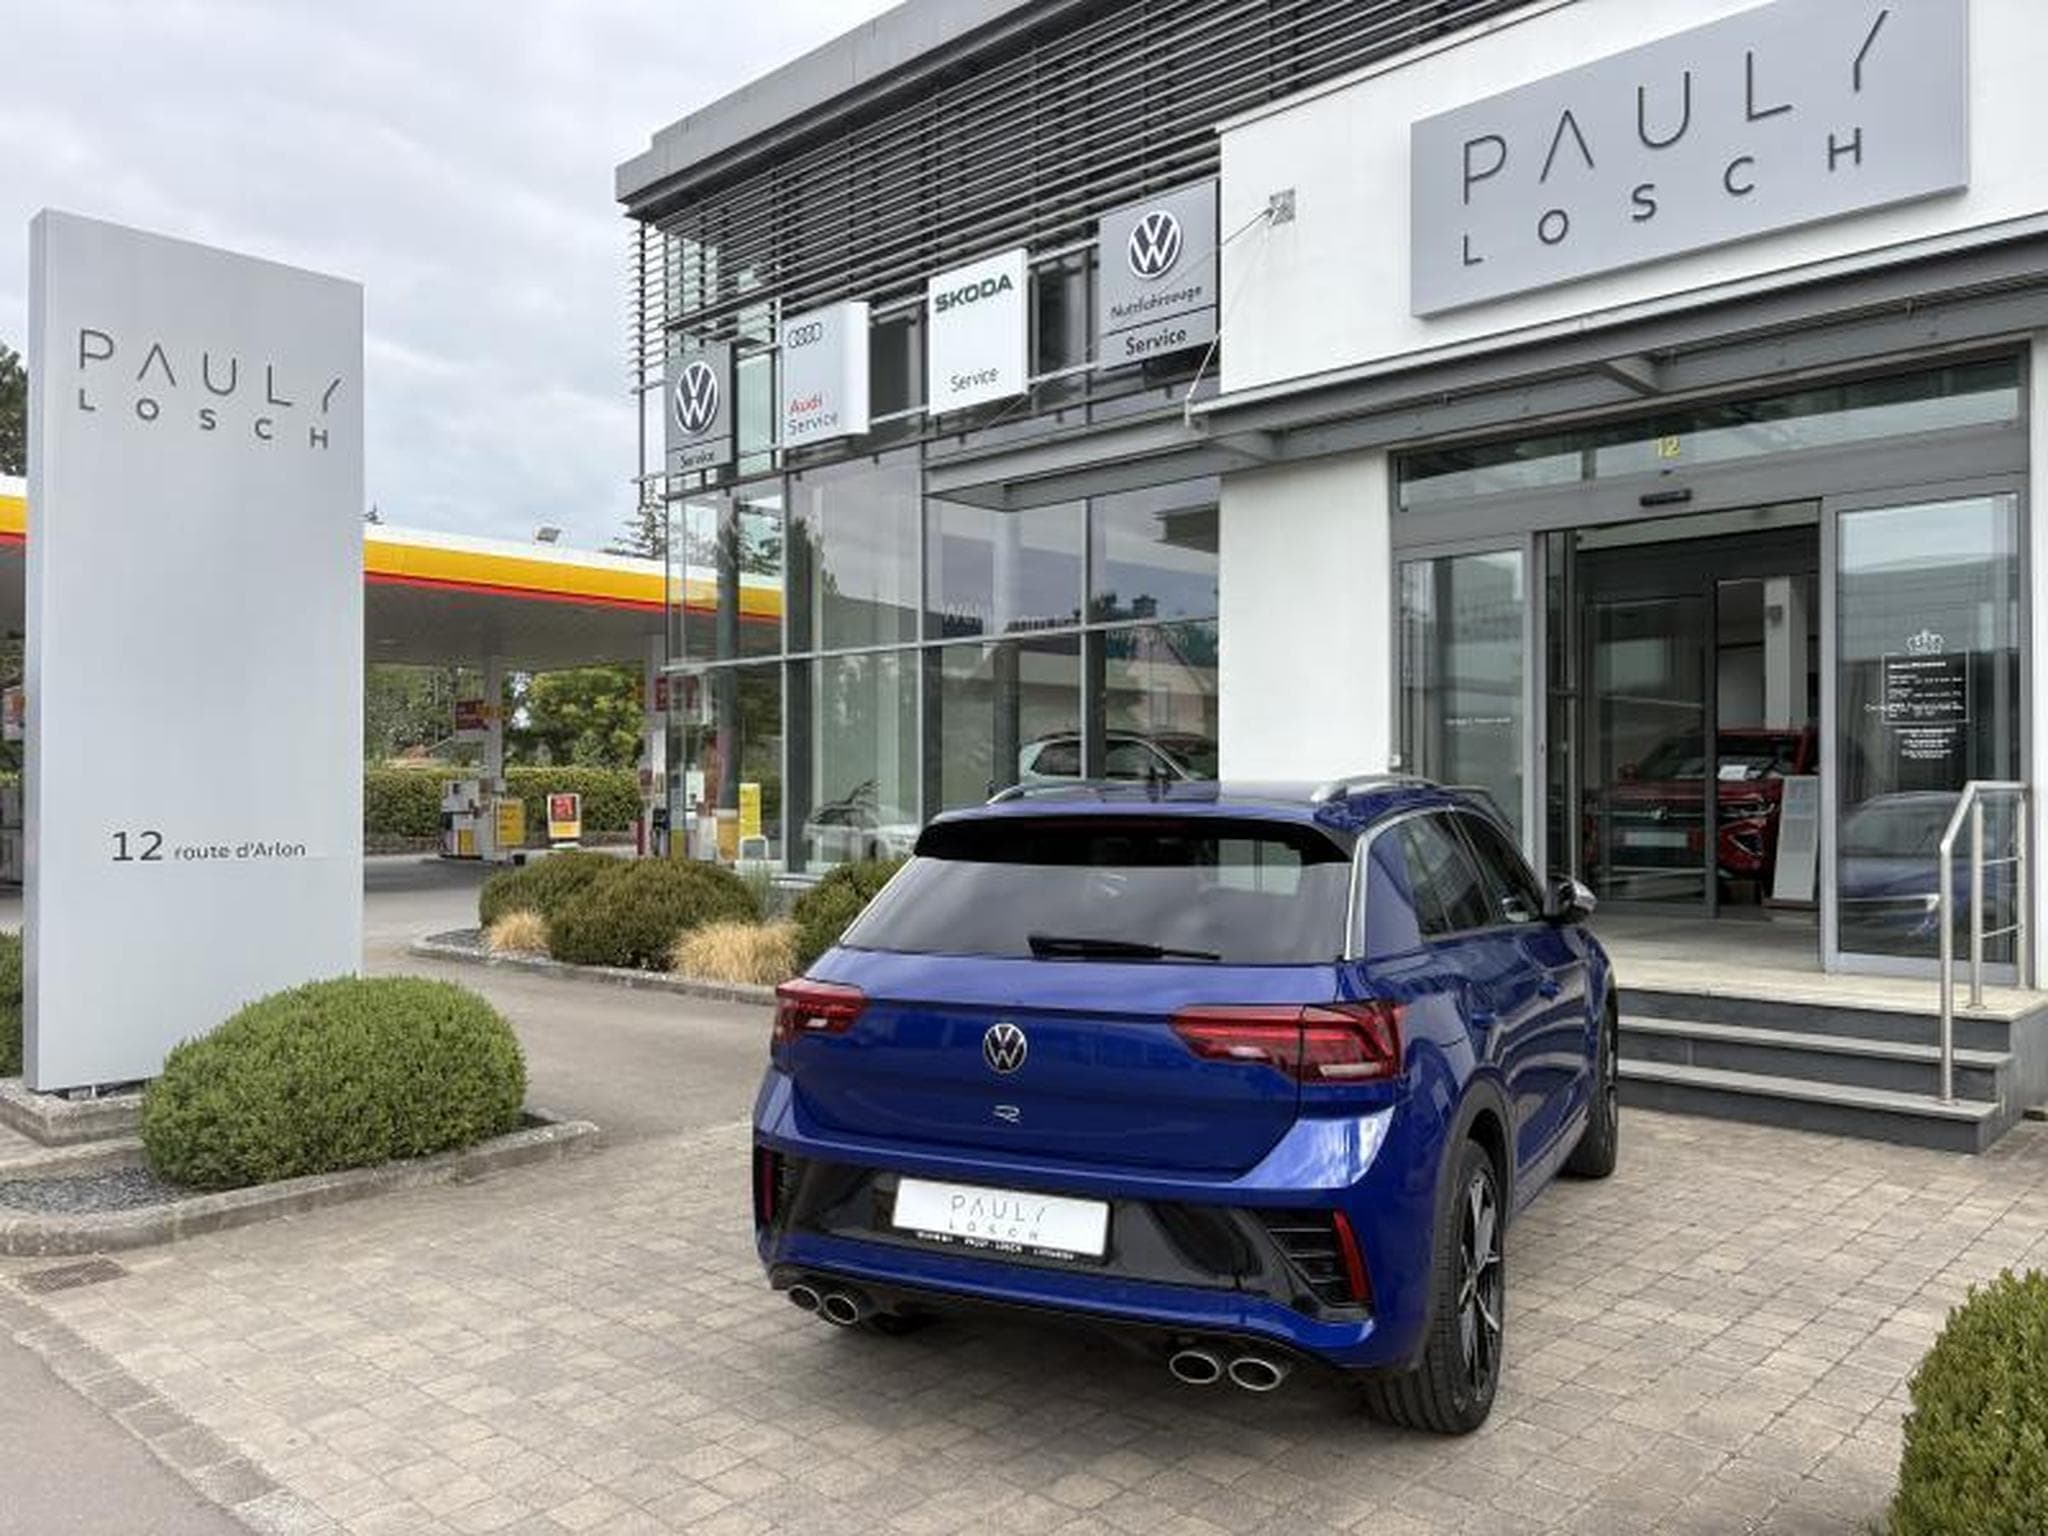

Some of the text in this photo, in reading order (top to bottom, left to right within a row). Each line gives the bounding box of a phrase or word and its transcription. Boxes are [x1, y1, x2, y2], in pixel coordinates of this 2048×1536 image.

[1464, 9, 1889, 205] PAULY
[1462, 127, 1863, 267] LOSCH
[1125, 327, 1188, 357] Service
[79, 328, 342, 414] PAULY
[950, 367, 999, 393] Service
[79, 388, 329, 450] LOSCH
[790, 394, 822, 414] Audi
[788, 412, 838, 436] Service
[112, 830, 307, 861] 12 route d'Arlon
